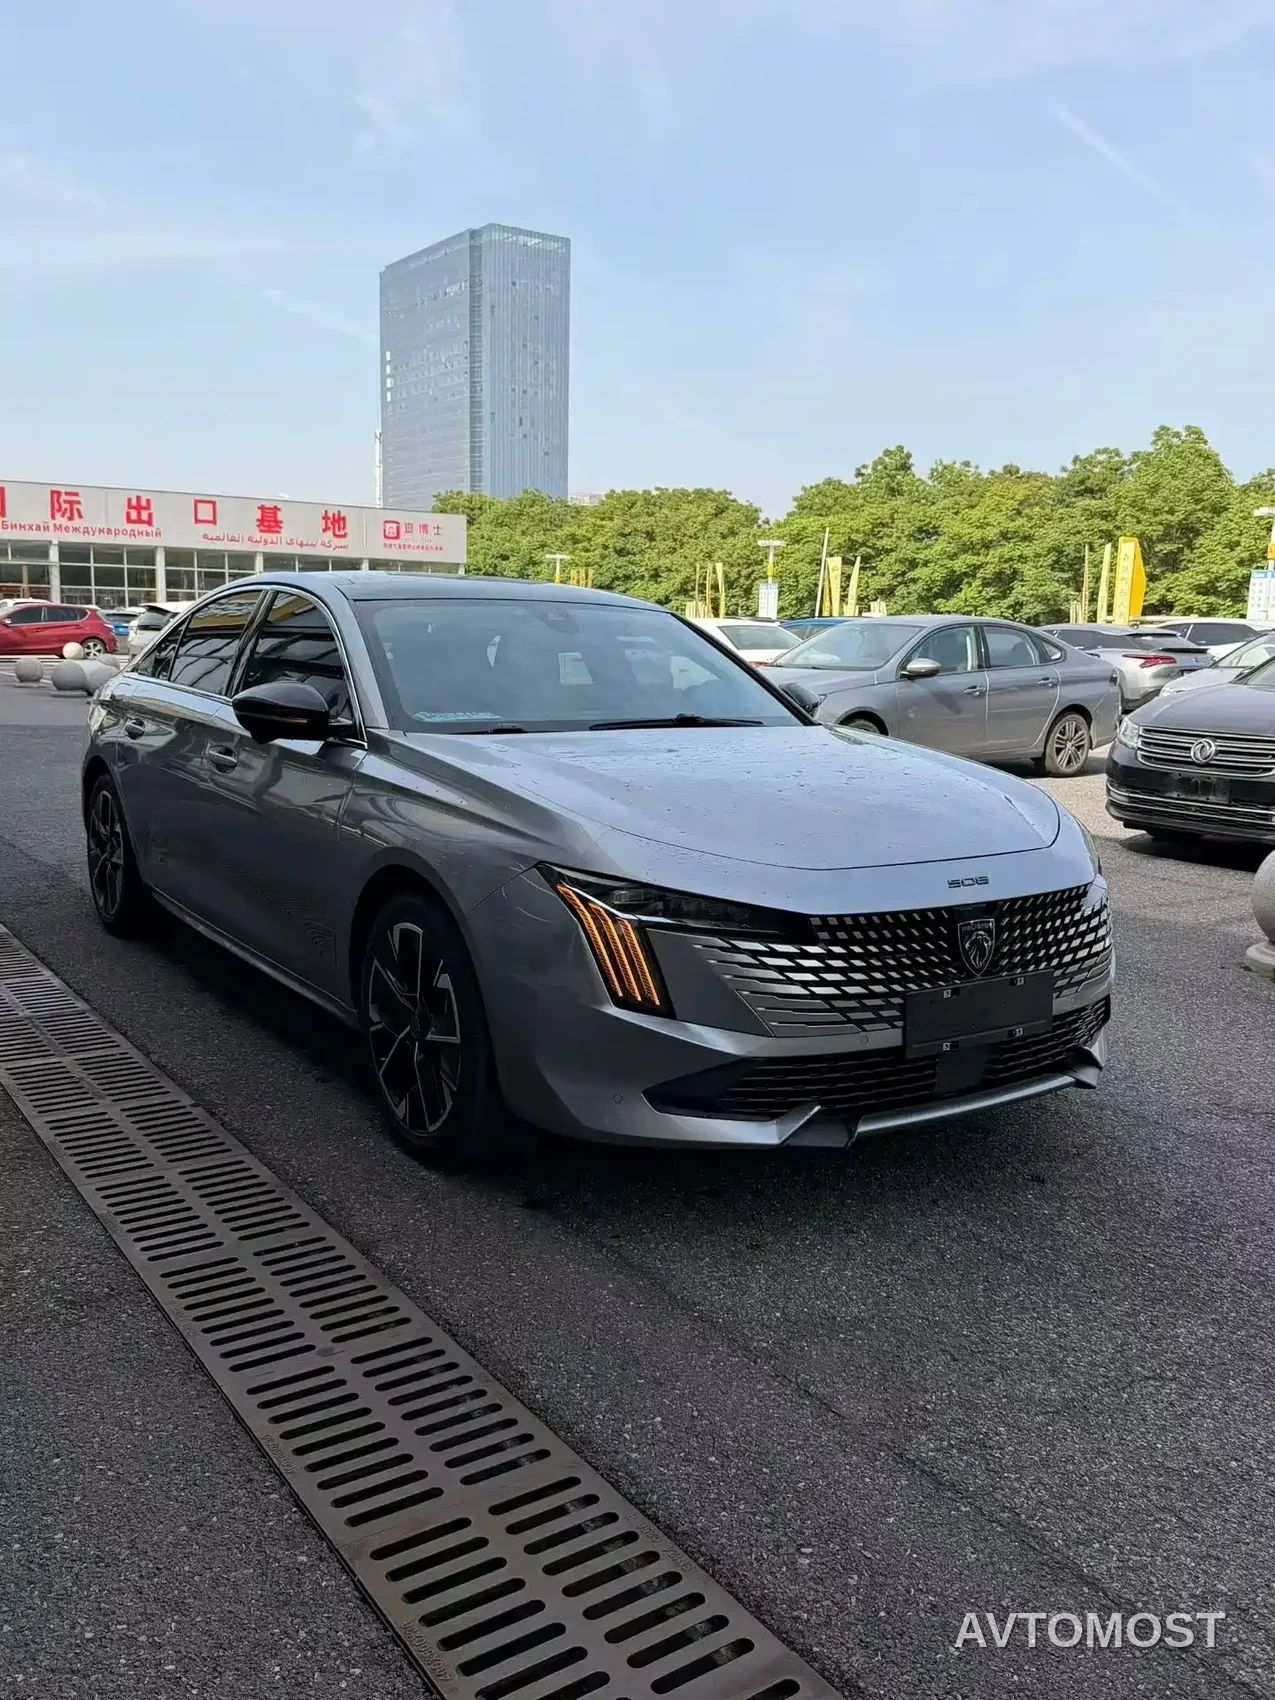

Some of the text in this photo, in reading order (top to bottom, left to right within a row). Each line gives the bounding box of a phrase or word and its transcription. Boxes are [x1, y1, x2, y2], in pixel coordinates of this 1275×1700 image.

[0, 486, 348, 538] 际出口基地
[1, 520, 162, 538] Бинхай Международный
